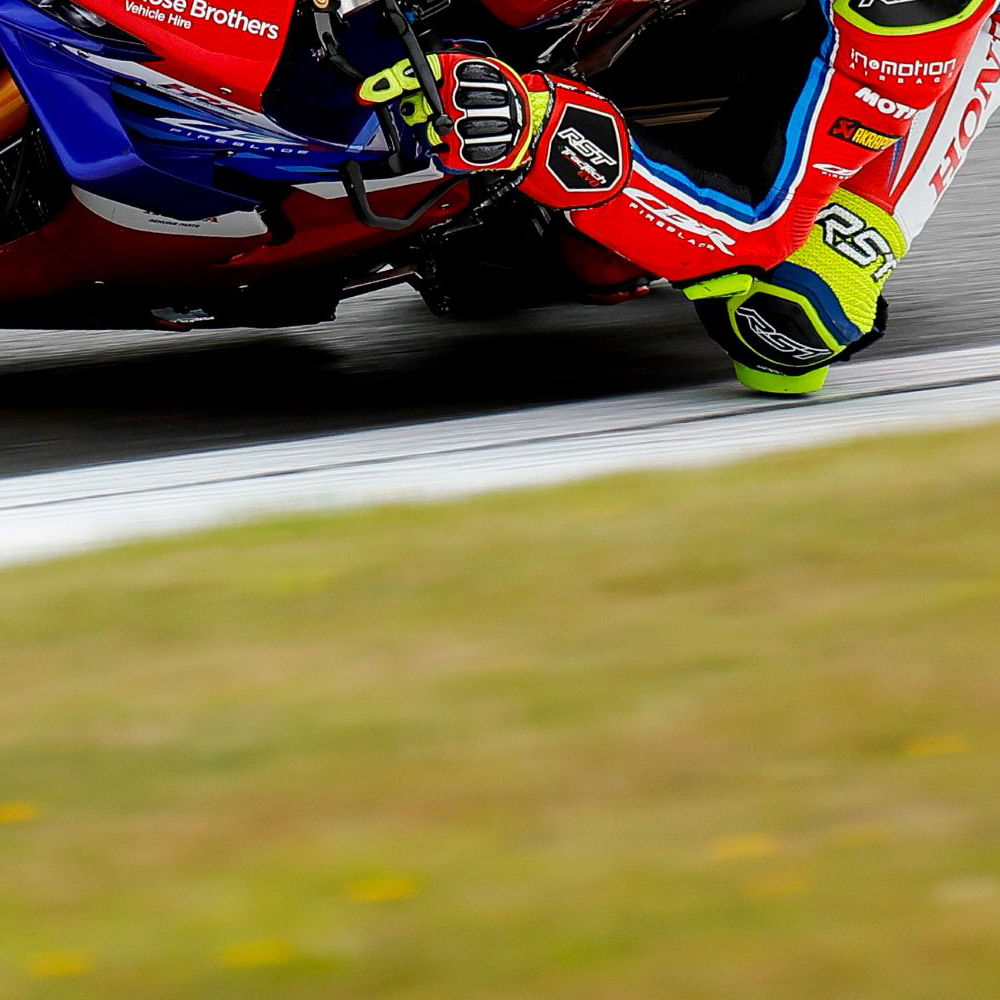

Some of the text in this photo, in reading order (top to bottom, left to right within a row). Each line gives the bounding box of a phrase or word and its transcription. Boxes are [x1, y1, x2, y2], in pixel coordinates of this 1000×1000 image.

[124, 0, 193, 30] Vehicle Hire
[169, 127, 310, 155] FIREBLADE
[557, 127, 617, 169] RST
[622, 187, 736, 256] CBR
[735, 306, 833, 360] RST
